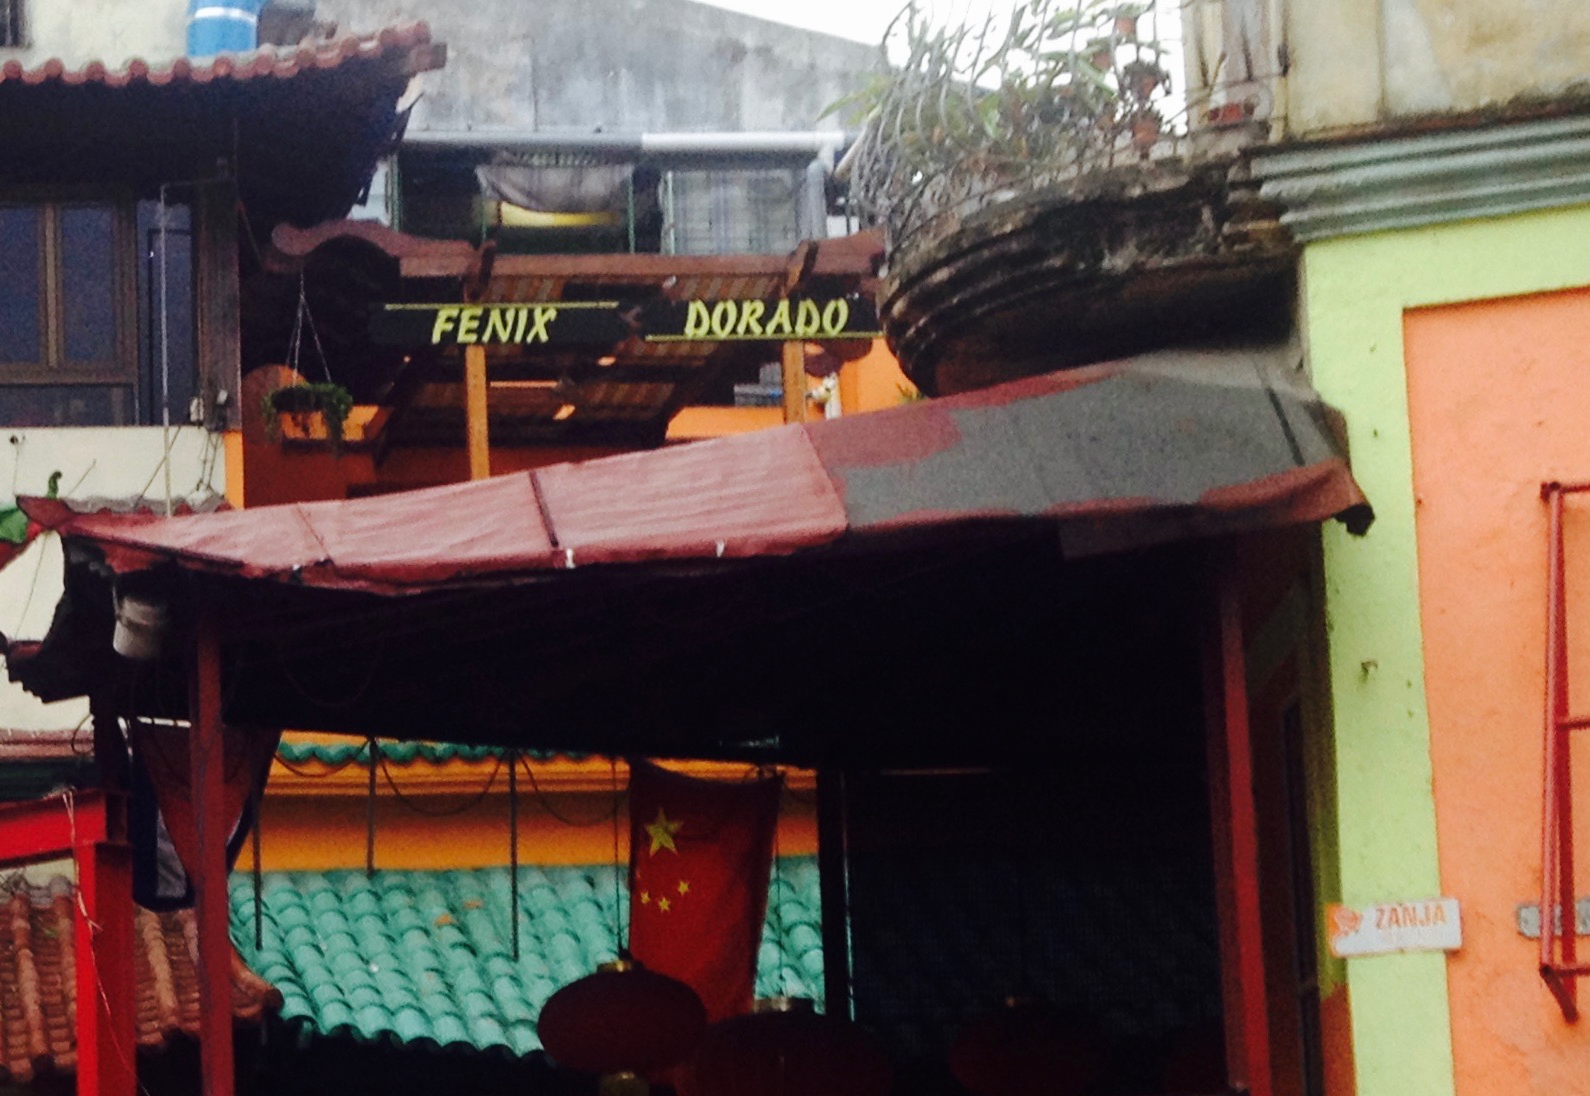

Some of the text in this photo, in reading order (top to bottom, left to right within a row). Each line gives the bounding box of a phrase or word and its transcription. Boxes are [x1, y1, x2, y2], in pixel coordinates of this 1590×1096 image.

[432, 298, 850, 344] FENIX DORADO
[1375, 904, 1448, 929] ZANJA
